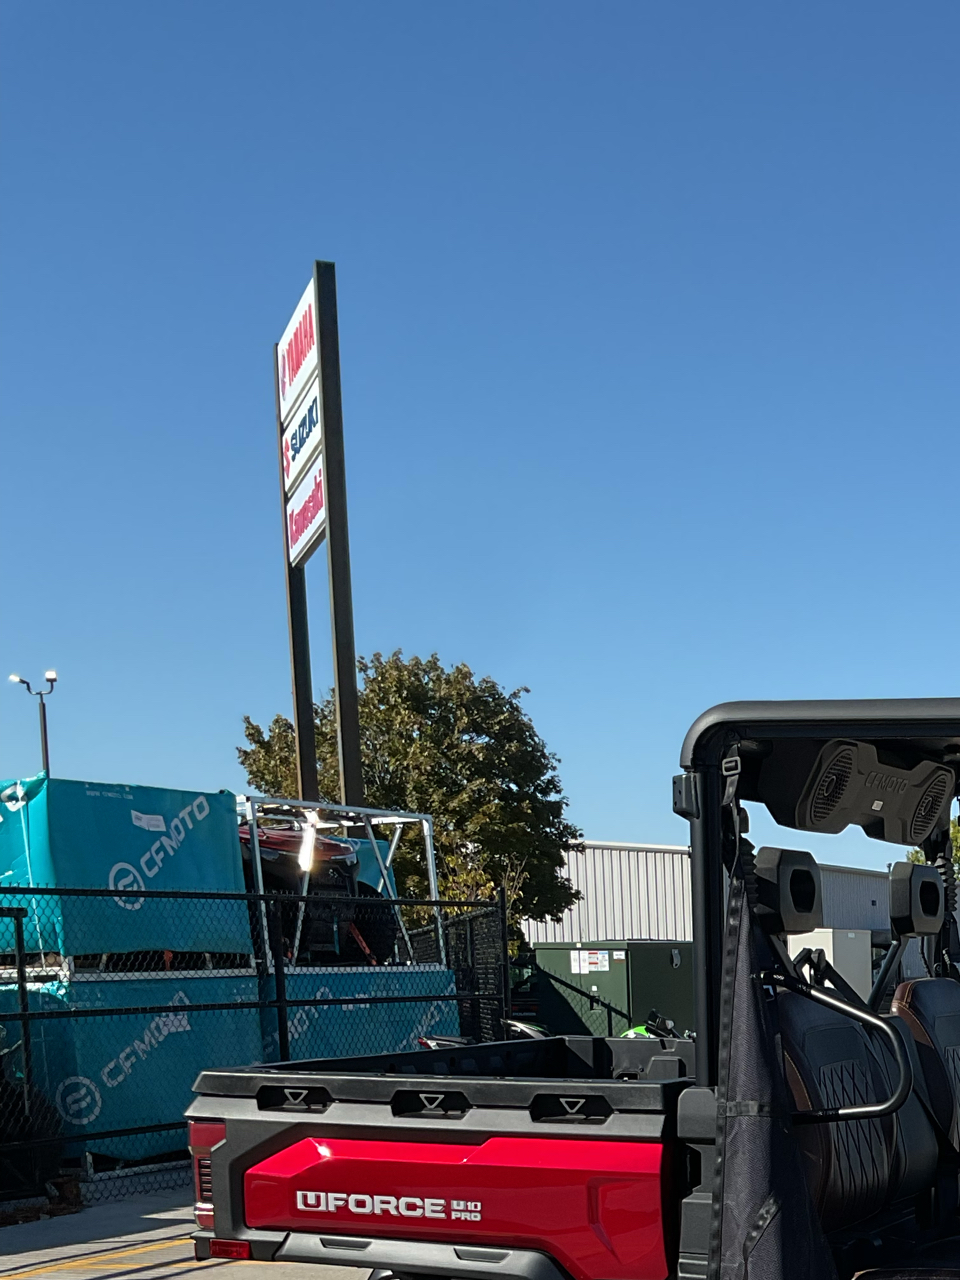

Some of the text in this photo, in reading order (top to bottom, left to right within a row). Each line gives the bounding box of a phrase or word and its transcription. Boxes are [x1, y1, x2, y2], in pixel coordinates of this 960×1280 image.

[286, 303, 315, 387] YAMAHA
[290, 395, 318, 462] SUZUKI
[865, 771, 909, 794] CFMOTO
[140, 795, 210, 878] CFMOTO
[296, 1190, 447, 1219] UFORCE
[451, 1200, 482, 1211] U10
[451, 1211, 482, 1221] PRO
